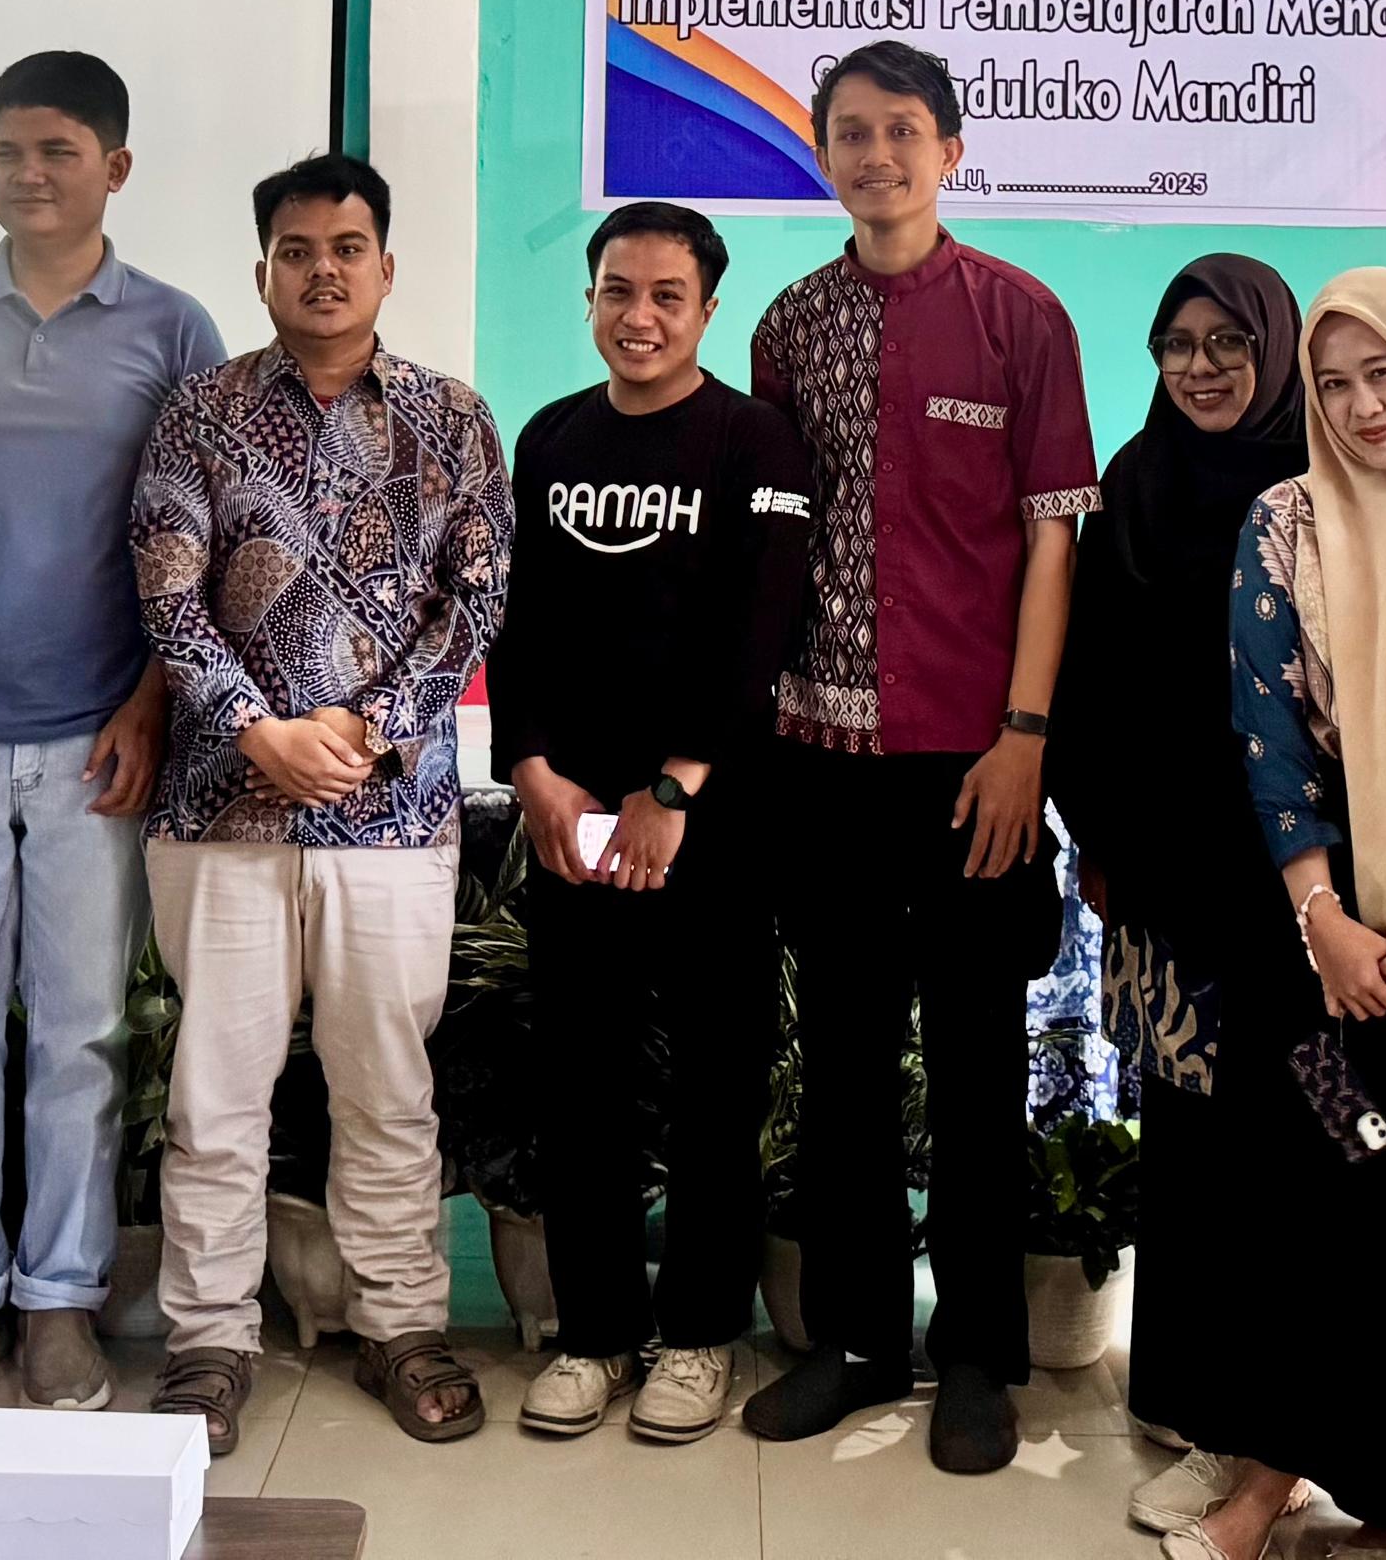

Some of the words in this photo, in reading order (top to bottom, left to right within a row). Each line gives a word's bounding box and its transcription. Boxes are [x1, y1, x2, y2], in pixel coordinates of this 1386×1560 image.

[1133, 59, 1315, 123] Mandiri
[939, 168, 991, 195] ALU,
[548, 482, 702, 553] RAMAH
